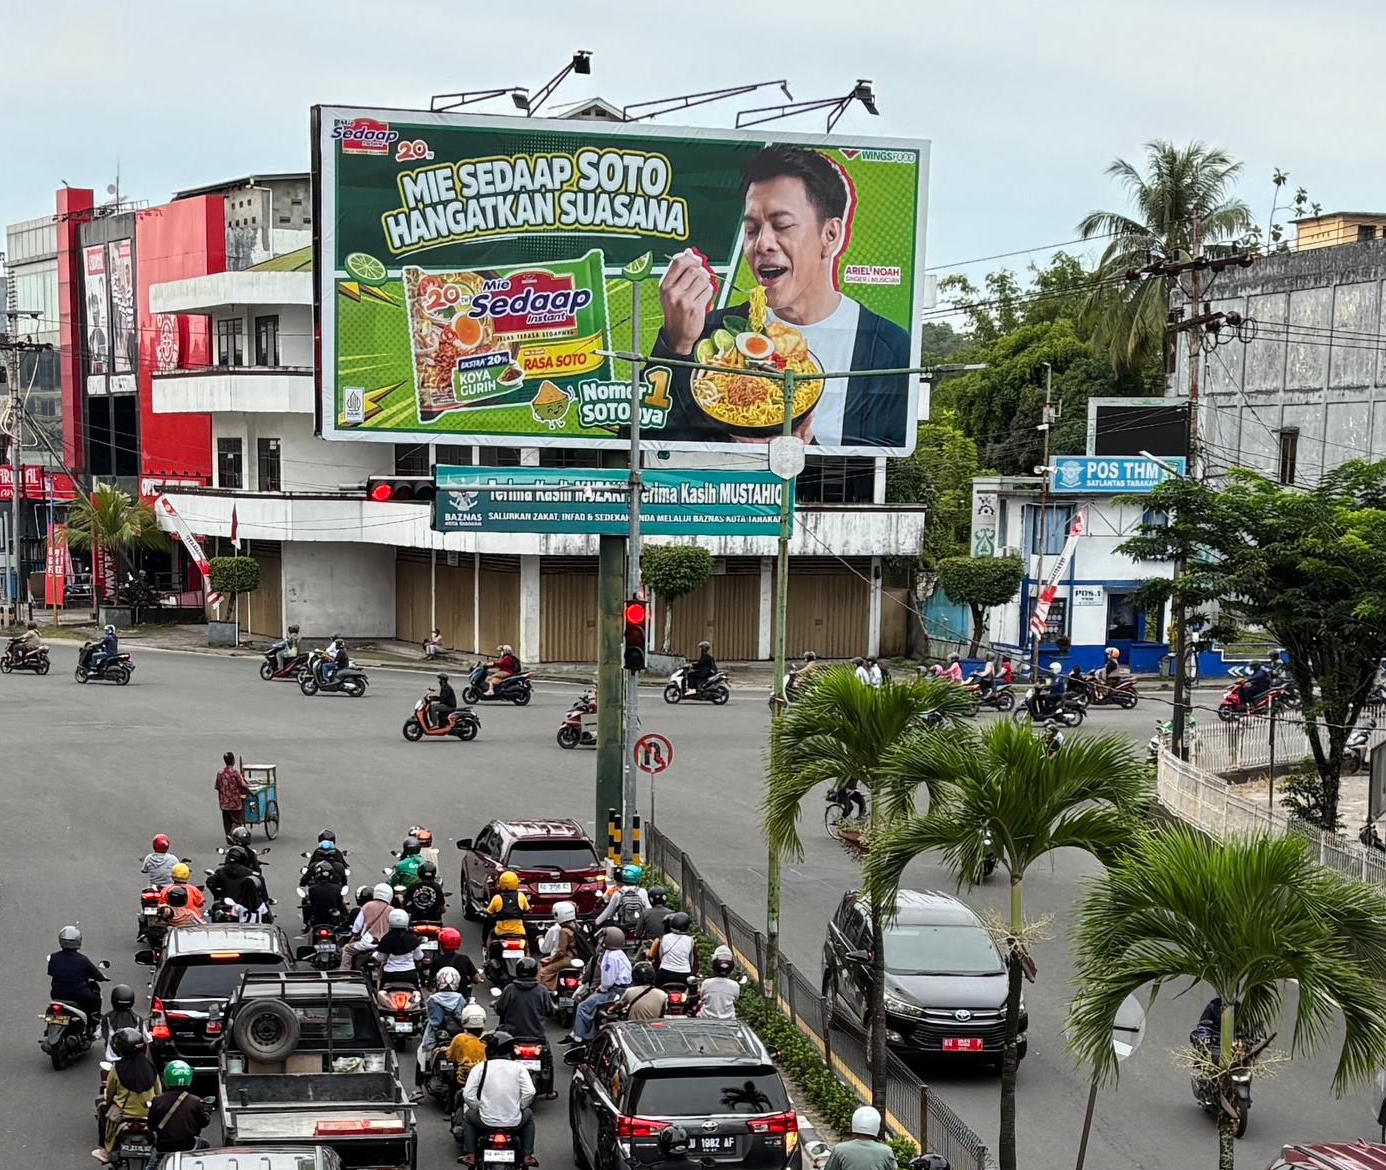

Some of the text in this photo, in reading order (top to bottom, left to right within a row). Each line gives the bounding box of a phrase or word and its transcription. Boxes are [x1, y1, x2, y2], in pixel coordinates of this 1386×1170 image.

[331, 126, 399, 143] Sedaap
[402, 151, 668, 207] MIE SEDAAP SOTO
[387, 190, 686, 249] HANGATKAN SUASANA
[846, 266, 900, 277] ARIEL NOAH
[483, 279, 510, 292] Mie
[426, 285, 461, 311] 20
[469, 289, 591, 318] Sedaap
[526, 313, 566, 324] Instant
[524, 357, 554, 371] RASA
[555, 352, 587, 367] SOTO
[460, 371, 491, 385] KOYA
[460, 382, 497, 396] GURIH
[582, 404, 665, 425] SOTOya
[1087, 461, 1159, 479] POS THM
[641, 481, 678, 504] erima
[681, 482, 717, 504] Kasih
[444, 512, 483, 521] BAZNAS
[488, 511, 532, 521] SALURKAN
[639, 514, 655, 522] NDA
[723, 1137, 735, 1148] AF
